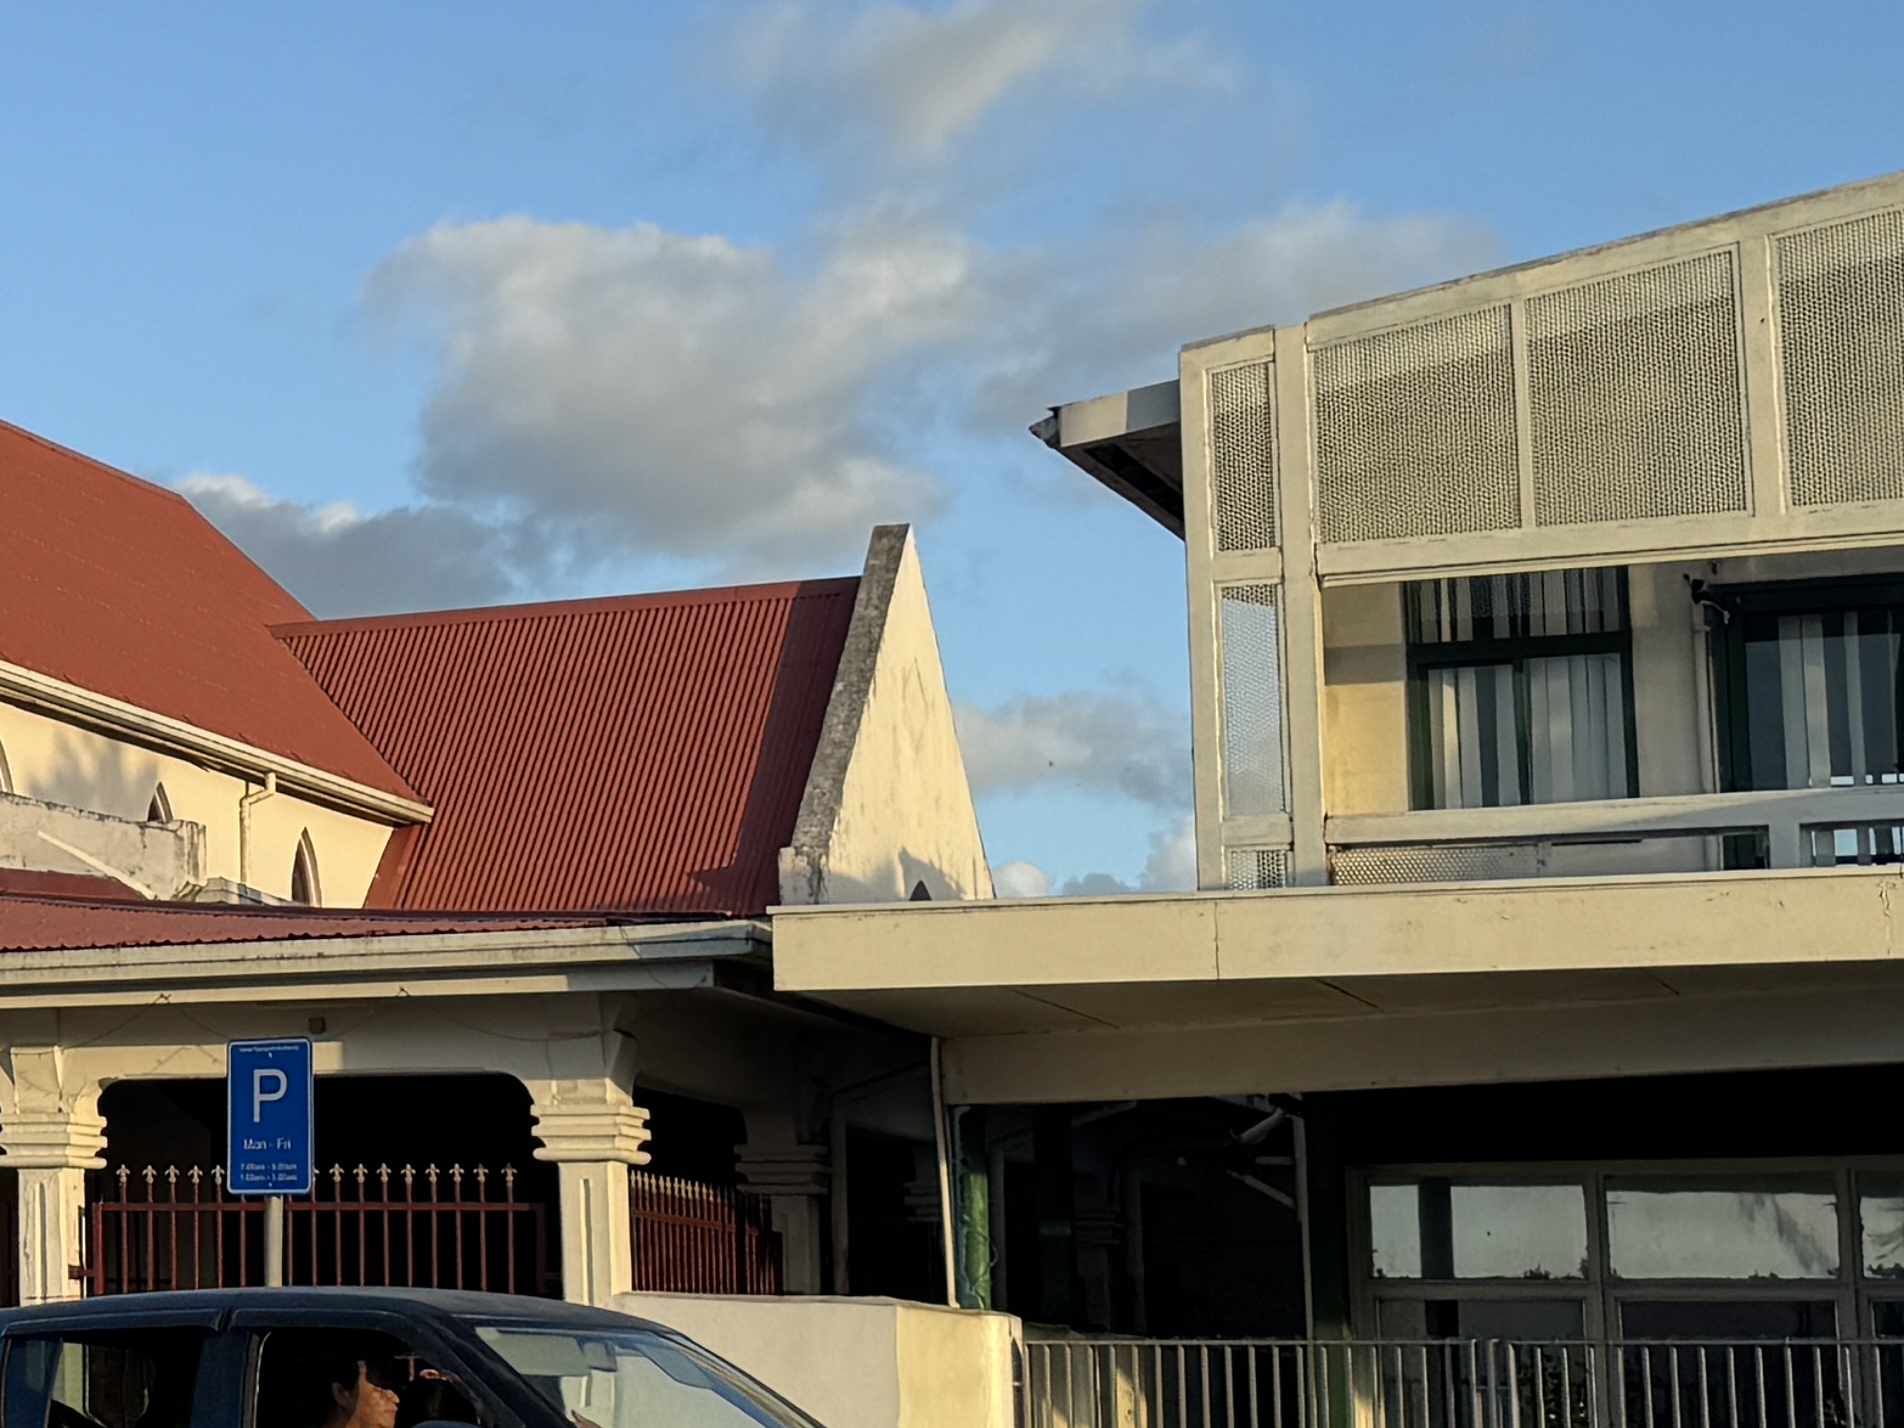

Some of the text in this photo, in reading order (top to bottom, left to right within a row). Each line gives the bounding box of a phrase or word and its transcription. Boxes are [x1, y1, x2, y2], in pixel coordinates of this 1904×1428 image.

[253, 1068, 288, 1123] P
[243, 1138, 267, 1150] Mon
[277, 1137, 291, 1149] Fri
